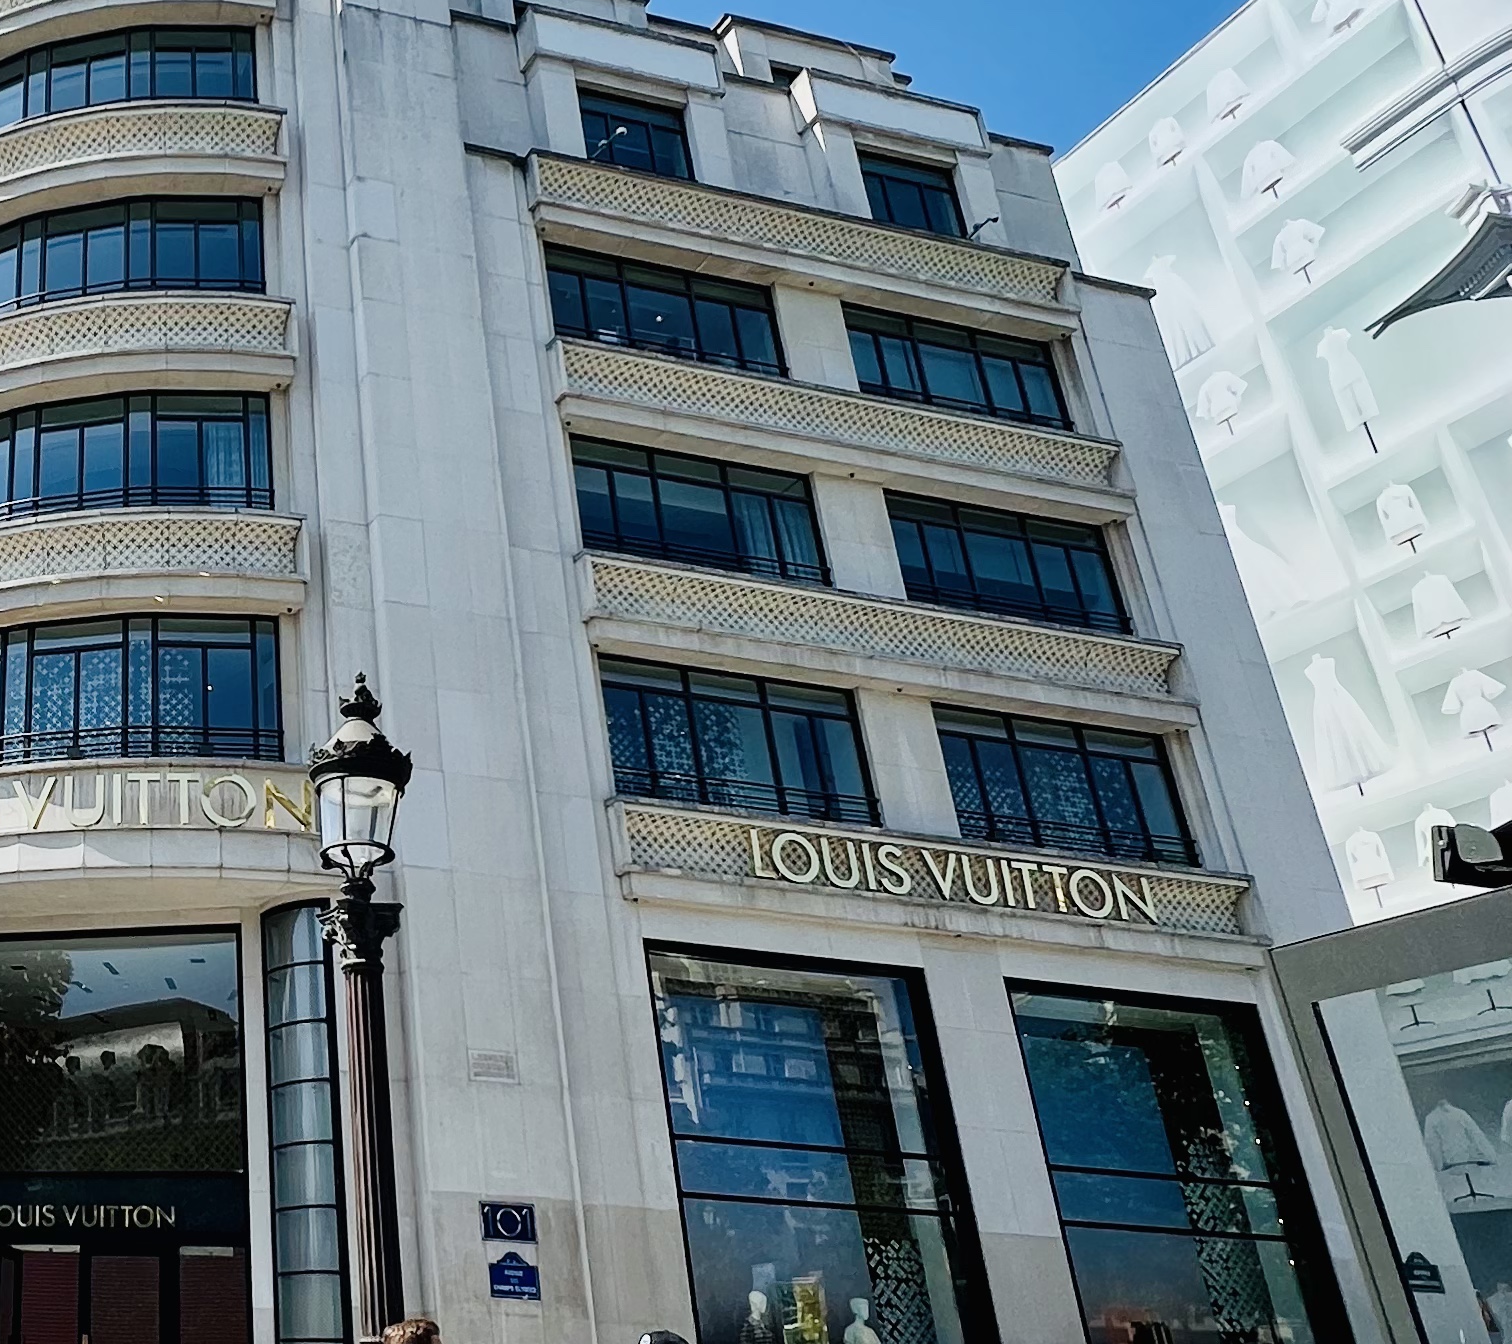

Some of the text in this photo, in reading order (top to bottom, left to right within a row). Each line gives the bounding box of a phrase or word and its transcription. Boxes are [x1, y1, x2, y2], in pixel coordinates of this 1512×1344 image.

[12, 771, 314, 832] VUITTON
[749, 828, 1158, 924] LOUIS VUITTON
[62, 1204, 177, 1229] VUITTON
[483, 1205, 533, 1239] 101
